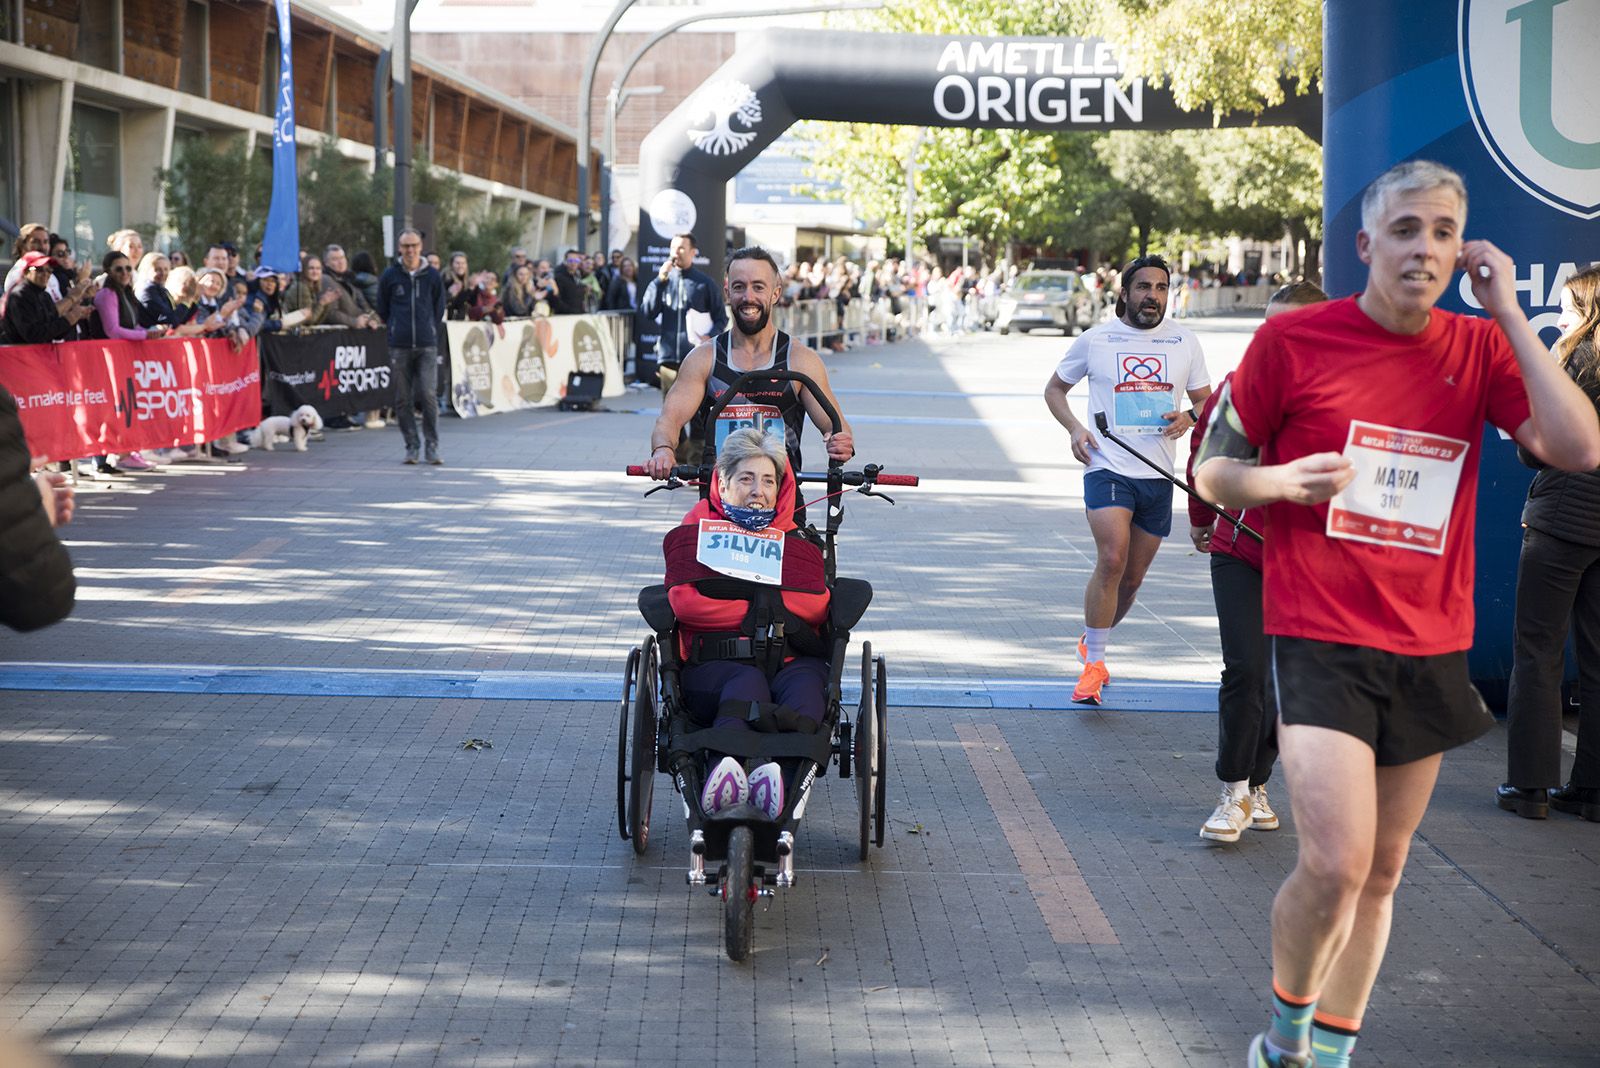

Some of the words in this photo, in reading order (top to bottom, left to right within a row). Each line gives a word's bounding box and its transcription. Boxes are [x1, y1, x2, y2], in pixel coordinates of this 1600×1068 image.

[933, 75, 1144, 124] ORIGEN
[335, 345, 366, 369] RPM
[338, 365, 391, 393] SPORTS
[28, 389, 64, 409] make
[84, 388, 108, 405] feel
[1408, 444, 1440, 456] CUGAT
